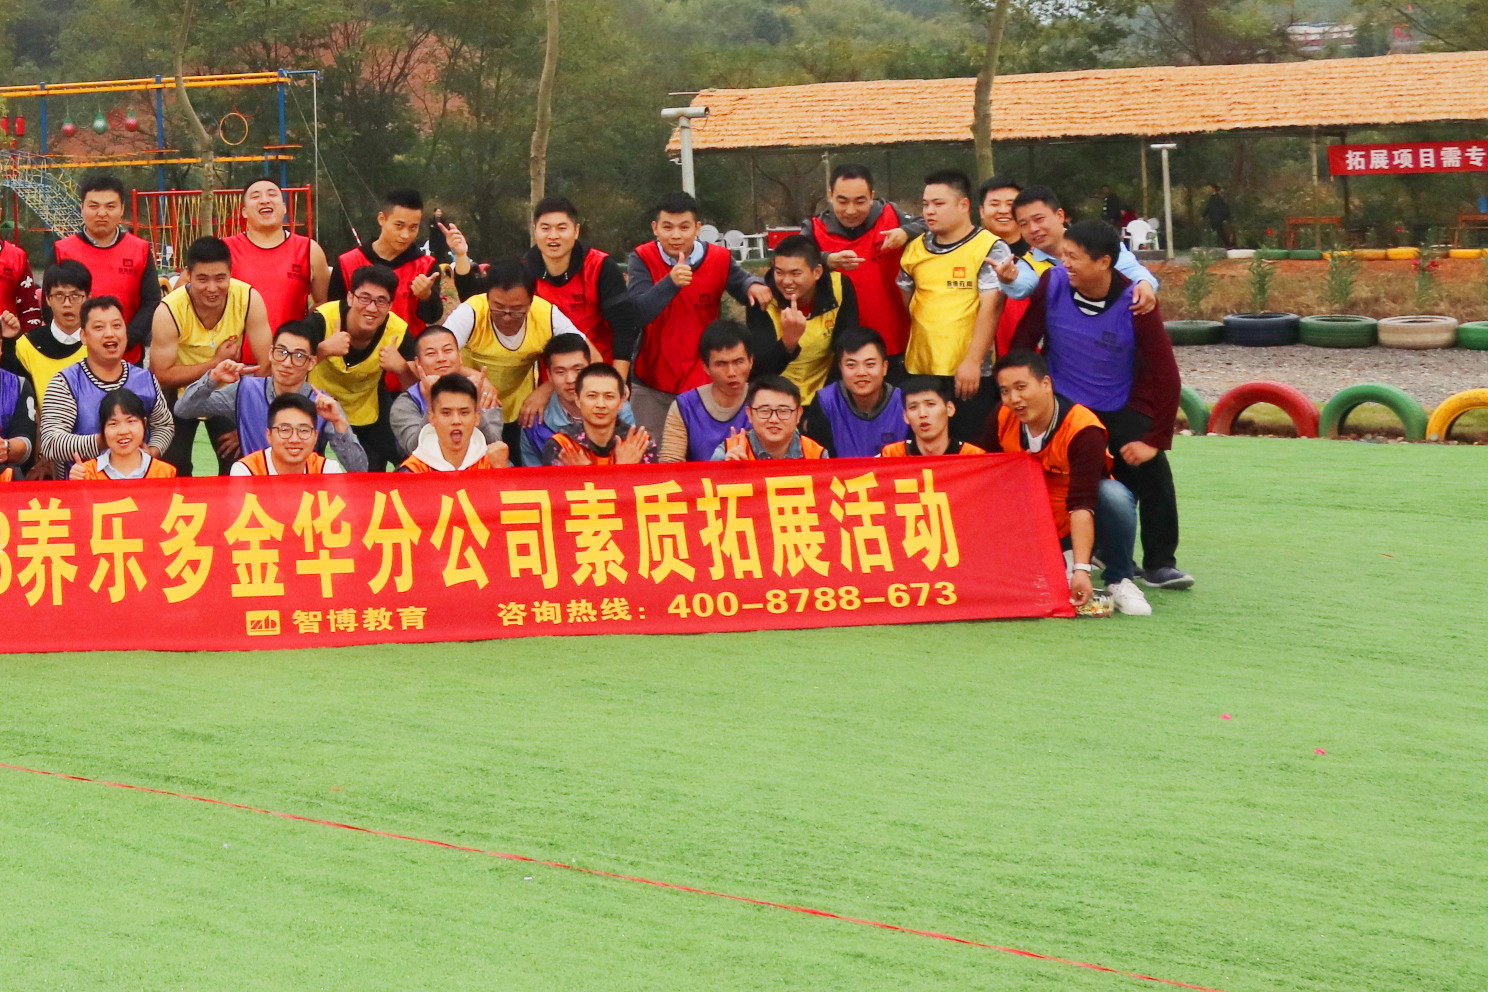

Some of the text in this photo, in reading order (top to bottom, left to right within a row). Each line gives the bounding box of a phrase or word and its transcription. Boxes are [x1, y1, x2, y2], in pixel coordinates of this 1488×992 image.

[1345, 145, 1487, 171] 拓展项目需专
[292, 605, 428, 634] 智博教育
